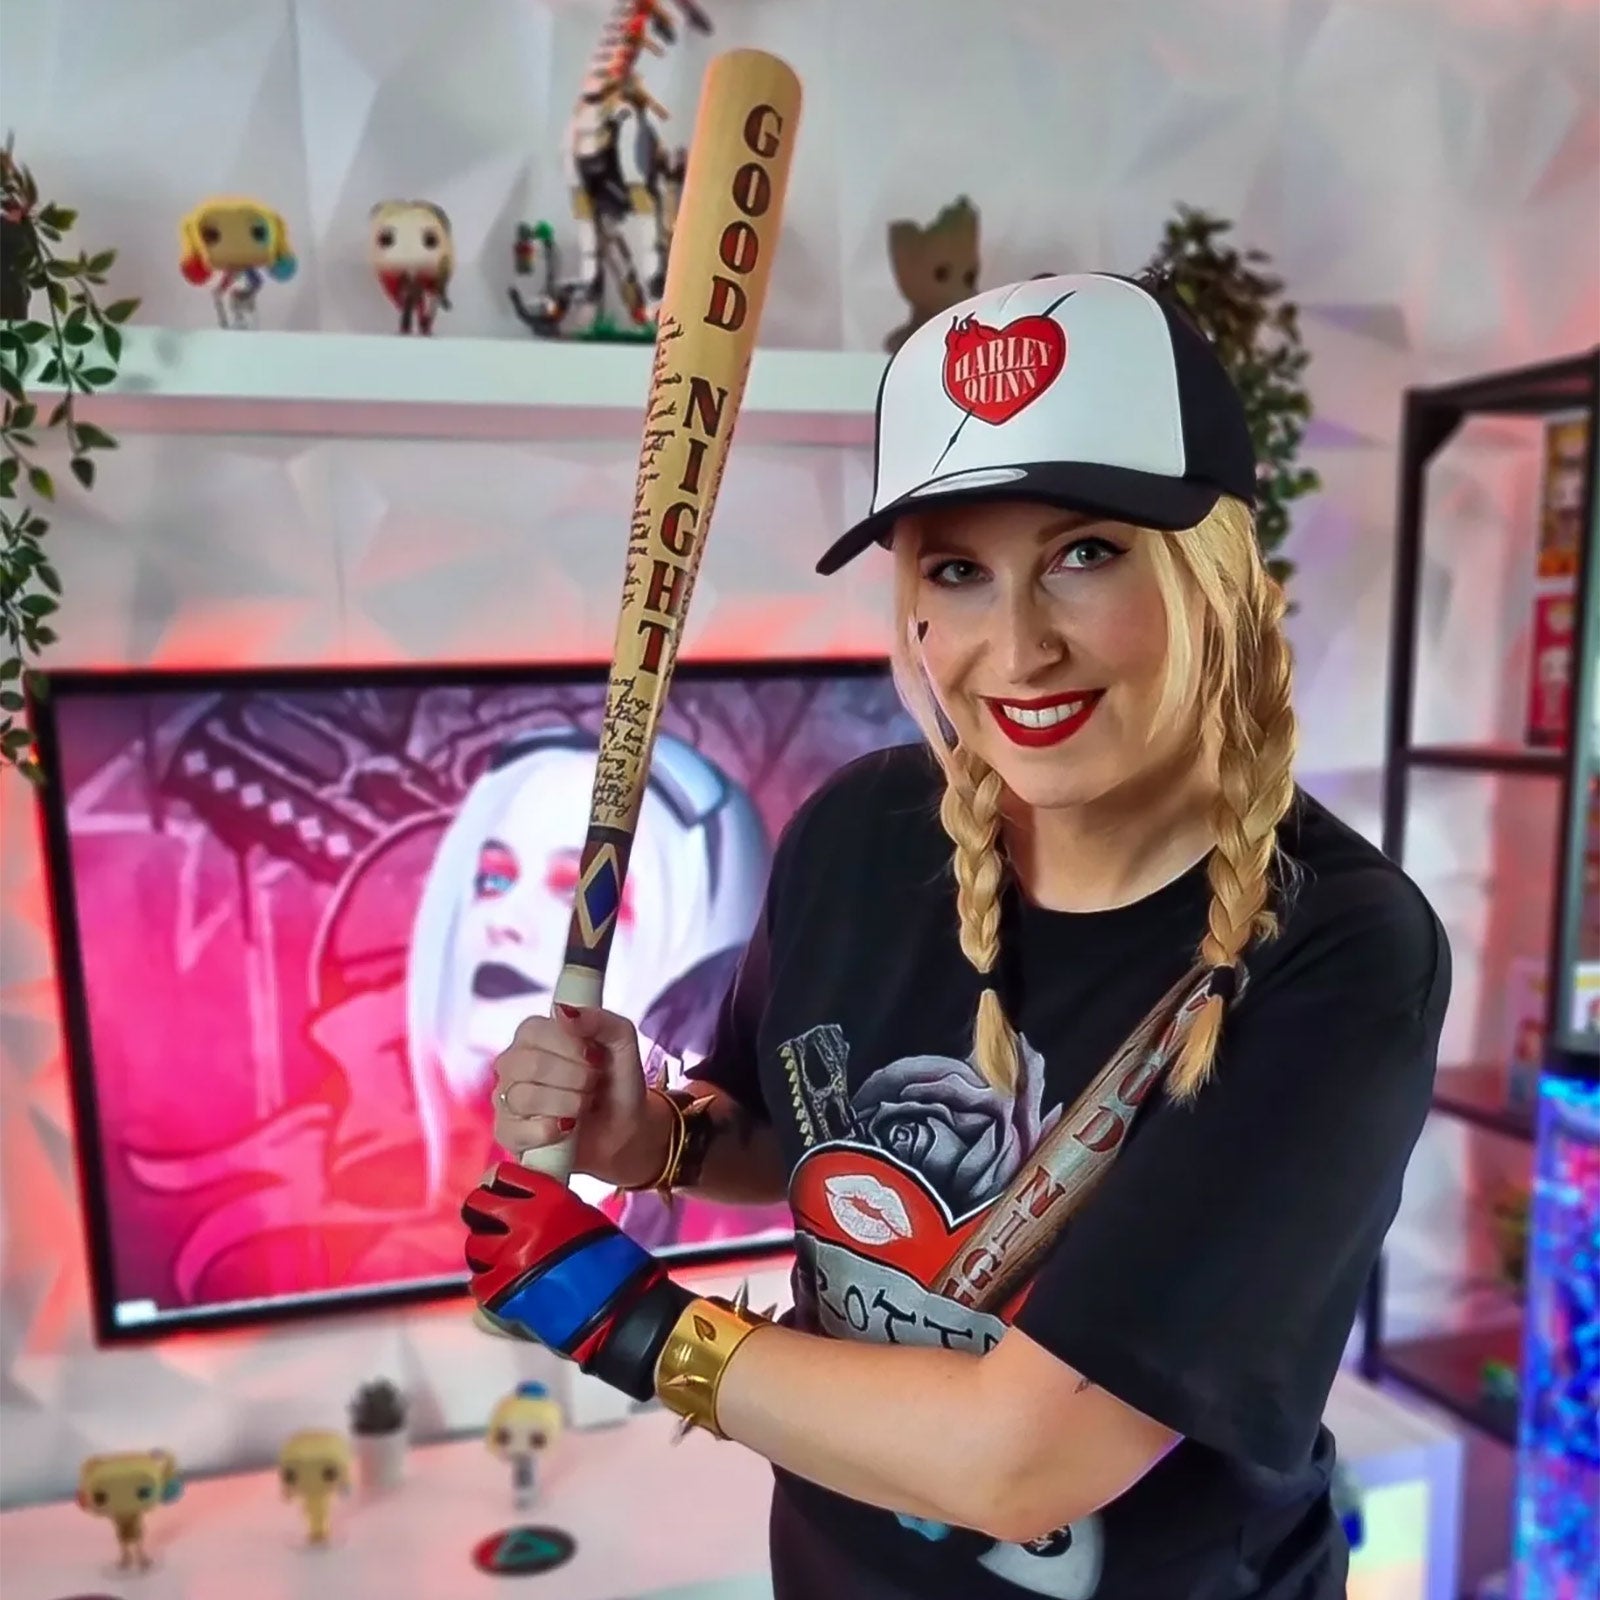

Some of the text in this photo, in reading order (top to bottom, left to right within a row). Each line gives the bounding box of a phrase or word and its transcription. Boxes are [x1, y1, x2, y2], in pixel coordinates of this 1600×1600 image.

[704, 104, 782, 332] GOOD
[955, 336, 1053, 382] HARLEY
[964, 368, 1038, 404] QUINN
[637, 376, 728, 675] NIGHT
